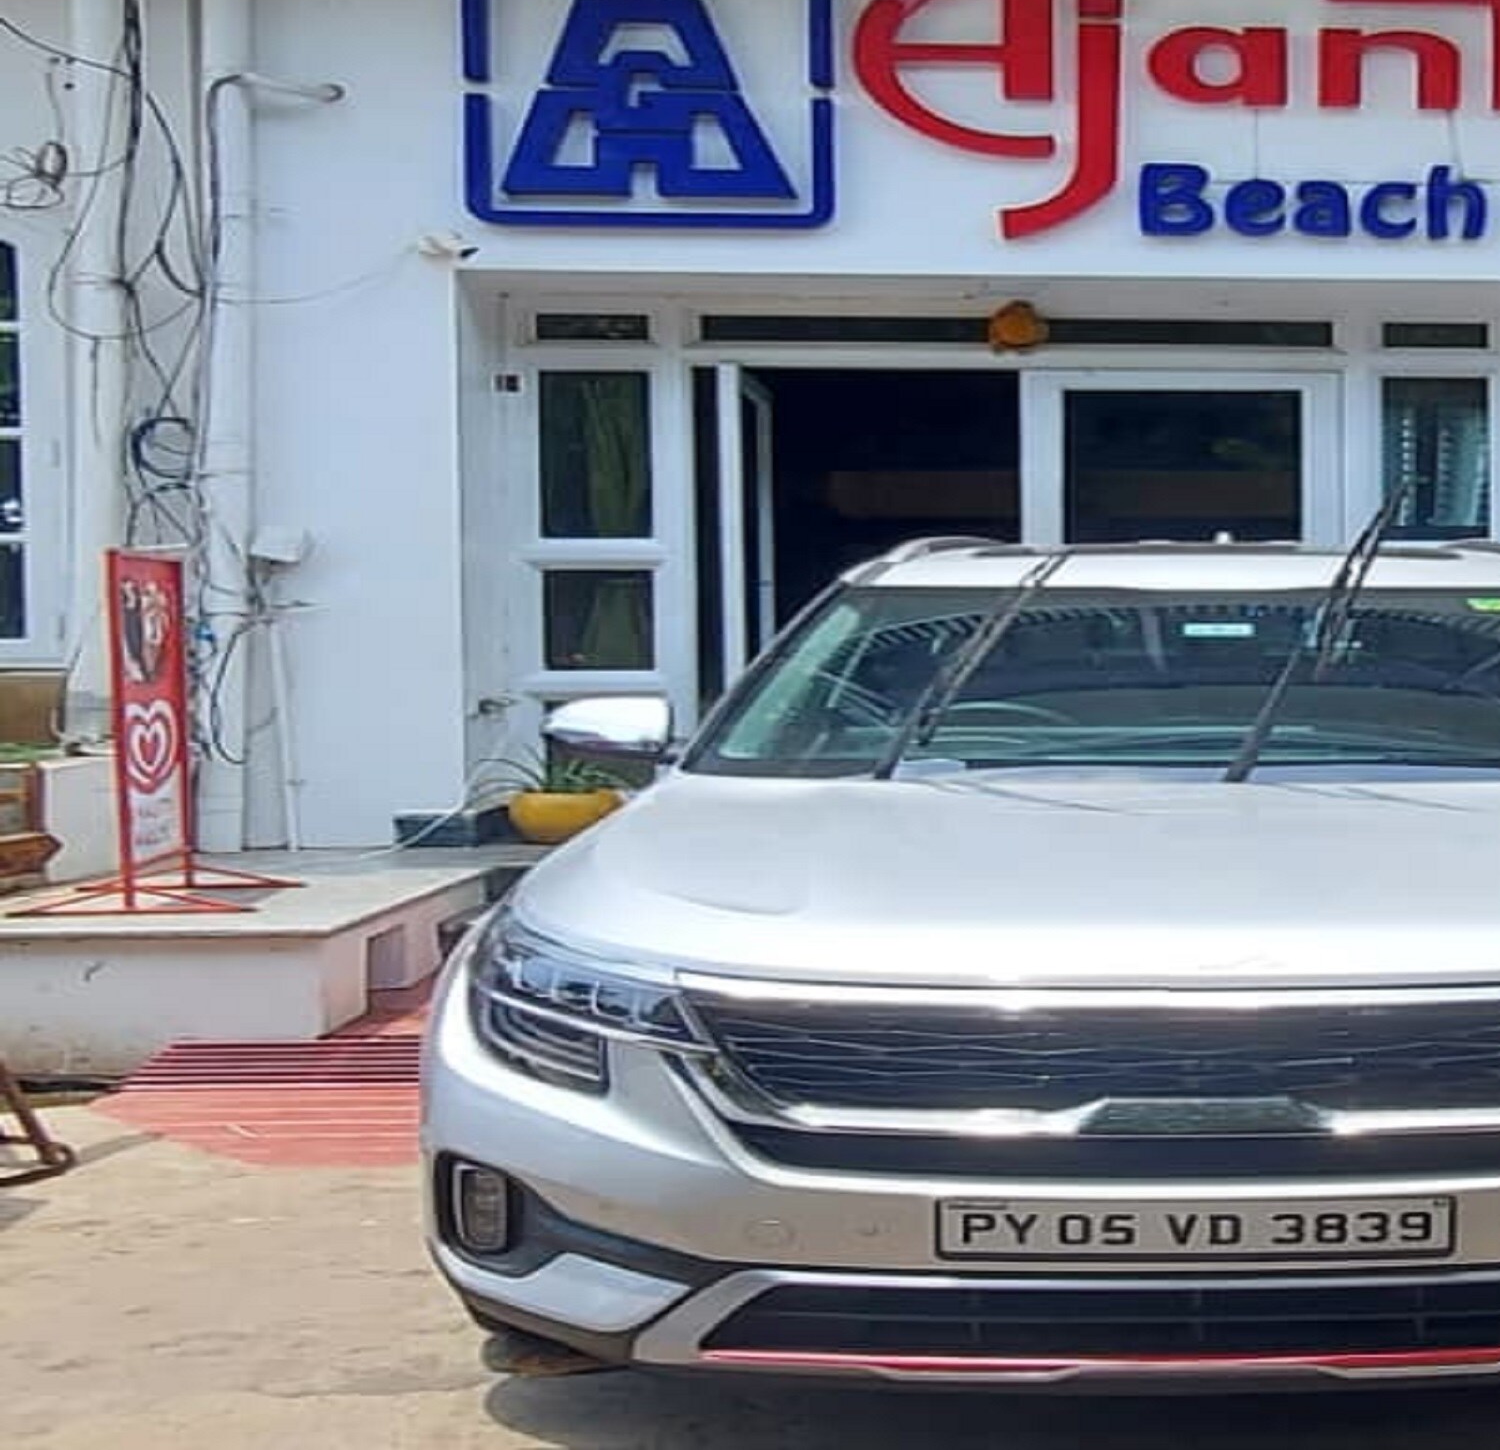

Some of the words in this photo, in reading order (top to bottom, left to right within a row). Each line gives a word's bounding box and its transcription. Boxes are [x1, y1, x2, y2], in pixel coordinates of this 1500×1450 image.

[1138, 162, 1488, 242] Beach
[962, 1213, 1039, 1246] PY
[1058, 1213, 1136, 1246] 05
[1165, 1213, 1243, 1246] VD
[1270, 1211, 1433, 1245] 3839
